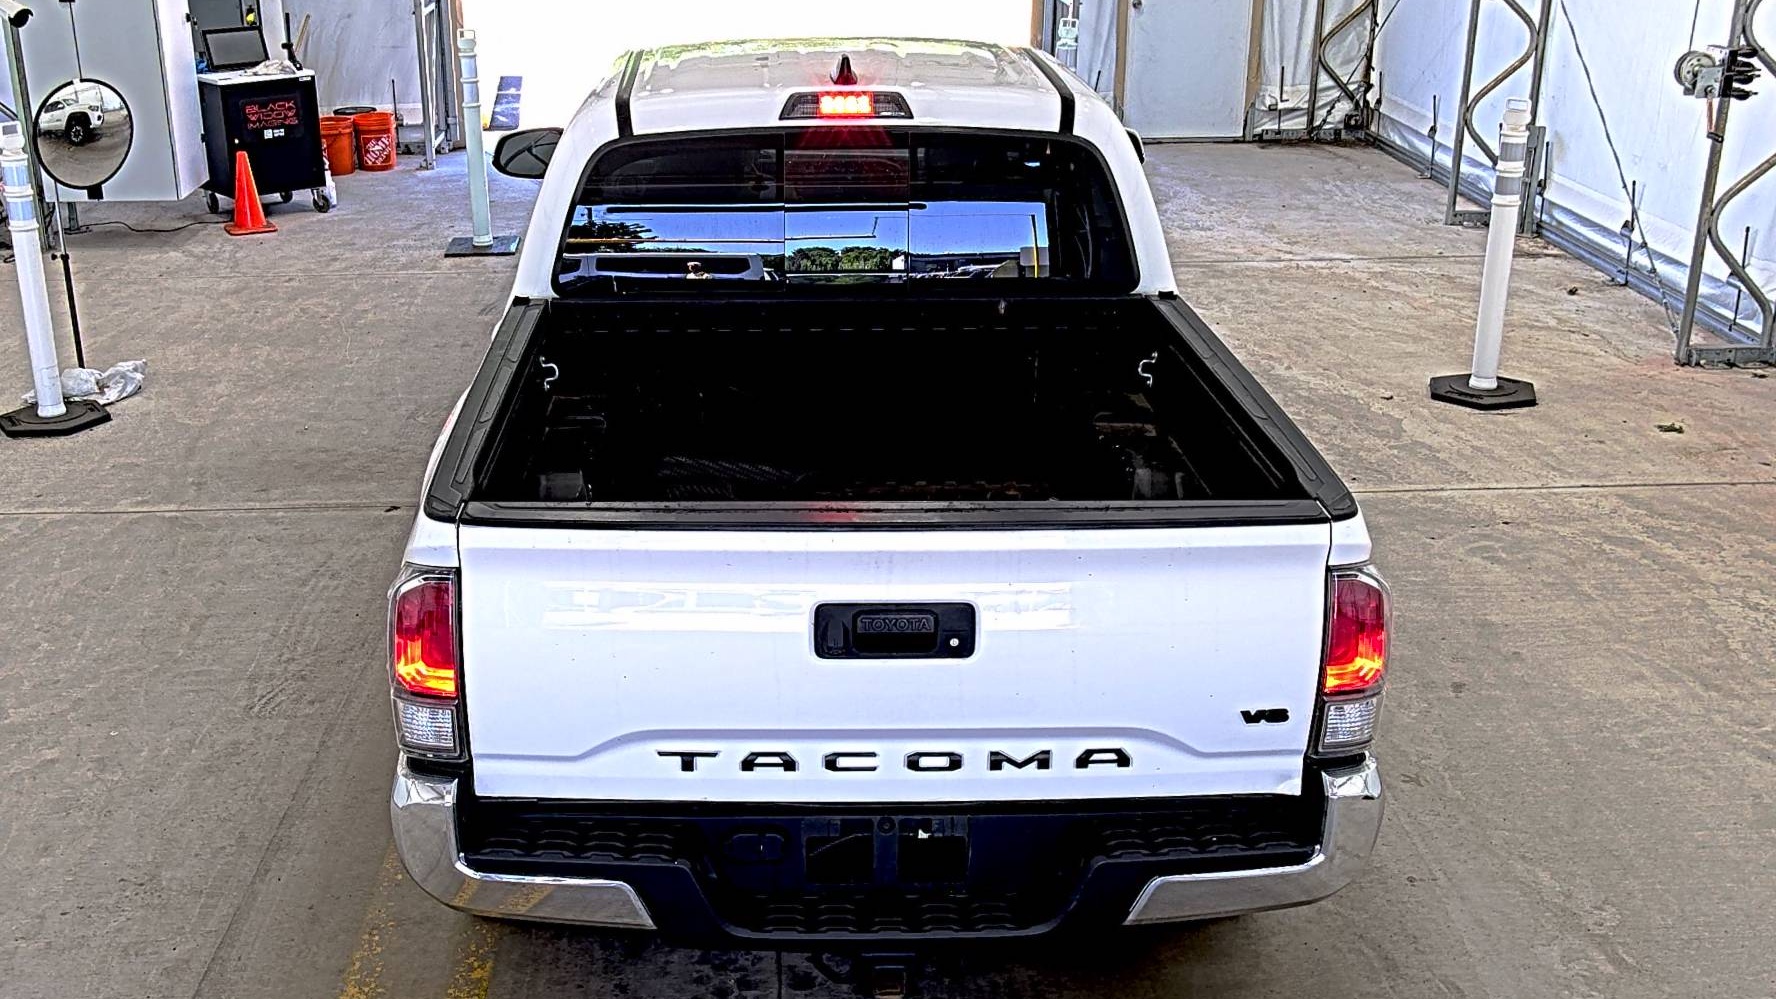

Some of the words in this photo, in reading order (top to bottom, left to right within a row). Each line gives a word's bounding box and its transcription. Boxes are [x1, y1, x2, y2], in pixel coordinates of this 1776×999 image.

[245, 100, 296, 114] BLACK
[246, 109, 296, 121] WIDOW
[247, 117, 298, 130] IMAGING
[363, 136, 390, 165] HOME
[861, 618, 931, 632] TOYOTA
[1239, 708, 1290, 724] V6
[656, 748, 1132, 773] TACOMA
